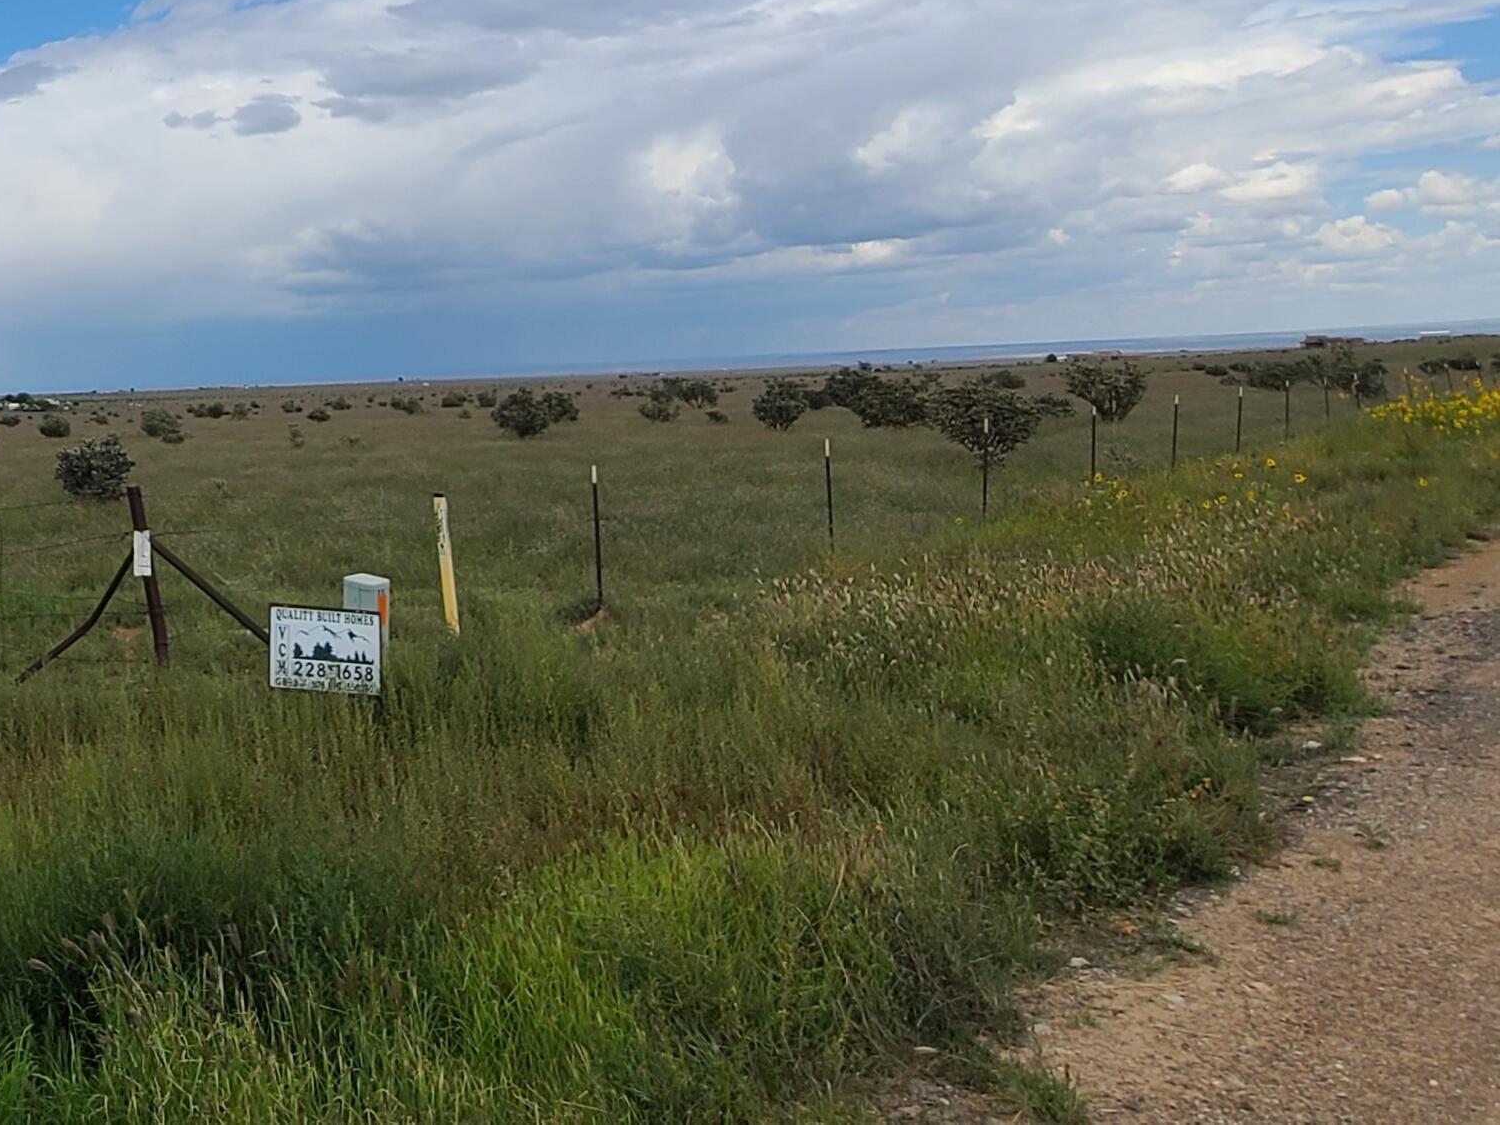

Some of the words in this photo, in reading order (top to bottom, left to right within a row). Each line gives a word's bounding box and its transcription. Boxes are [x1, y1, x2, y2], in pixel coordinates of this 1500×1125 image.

[276, 608, 313, 621] QUALITY
[317, 612, 340, 623] BUILT
[344, 614, 374, 626] HOMES
